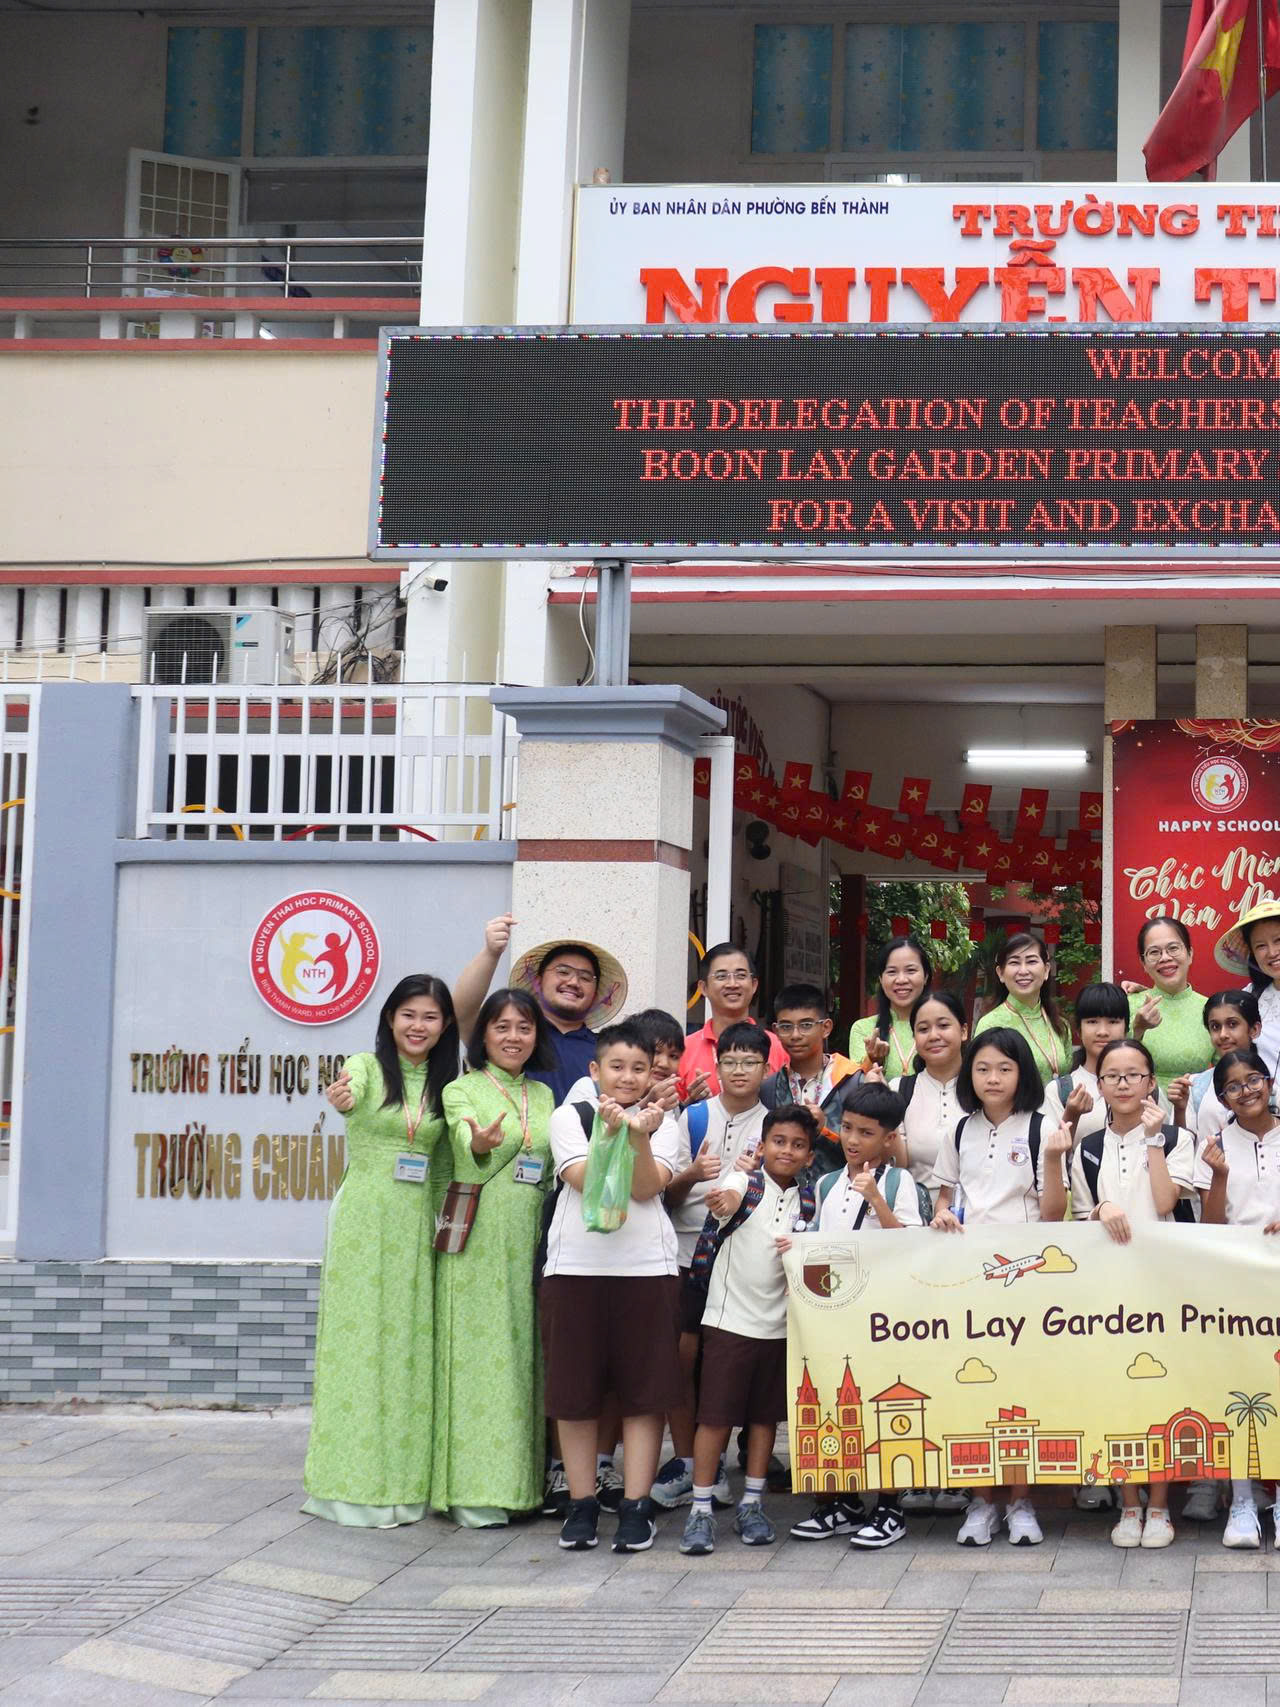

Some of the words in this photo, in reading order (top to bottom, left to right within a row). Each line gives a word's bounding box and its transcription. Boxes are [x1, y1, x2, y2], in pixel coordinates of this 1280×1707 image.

[609, 197, 627, 215] ỦY
[633, 202, 661, 215] BAN
[666, 199, 707, 215] NHÂN
[712, 199, 741, 215] DÂN
[746, 197, 806, 215] PHƯỜNG
[811, 194, 837, 215] BẾN
[843, 198, 889, 215] THÀNH
[952, 194, 1200, 237] TRƯỜNG
[639, 238, 1161, 324] NGUYỄN
[613, 399, 697, 431] THE
[706, 399, 987, 432] DELEGATION
[999, 399, 1057, 431] OF
[639, 449, 768, 481] BOON
[778, 449, 857, 481] LAY
[867, 448, 1053, 481] GARDEN
[1065, 448, 1270, 481] PRIMARY
[767, 499, 854, 532] FOR
[865, 500, 894, 532] A
[904, 499, 1016, 532] VISIT
[1025, 499, 1121, 532] AND
[1158, 820, 1212, 832] HAPPY
[1123, 857, 1205, 900] Chúc
[255, 920, 275, 962] NGUYEN
[272, 902, 294, 921] THAI
[294, 897, 317, 909] HOC
[319, 896, 361, 921] PRIMARY
[357, 921, 375, 963] SCHOOL
[302, 968, 327, 979] NTH
[130, 1044, 209, 1094] TRƯỜNG
[217, 1037, 261, 1094] TIỂU
[269, 1054, 309, 1103] HỌC
[133, 1121, 242, 1199] TRƯỜNG
[252, 1111, 345, 1201] CHUẨN
[870, 1312, 950, 1343] Boon
[966, 1309, 1026, 1346] Lay
[1042, 1304, 1165, 1336] Garden
